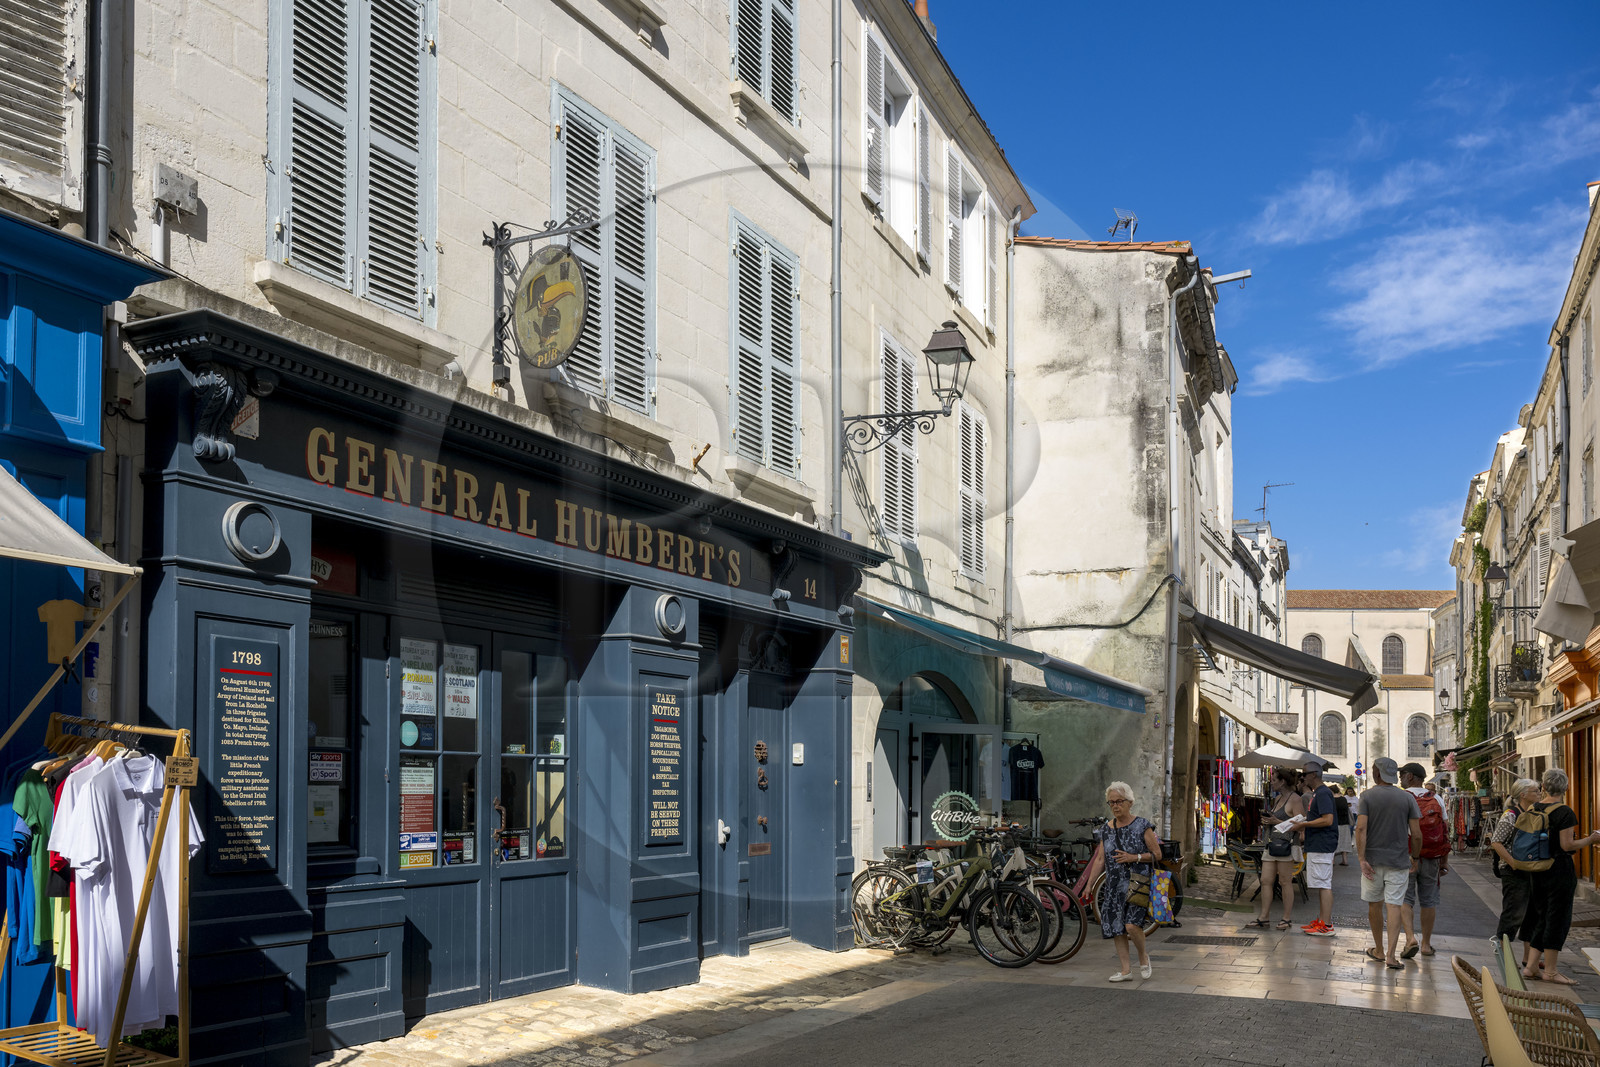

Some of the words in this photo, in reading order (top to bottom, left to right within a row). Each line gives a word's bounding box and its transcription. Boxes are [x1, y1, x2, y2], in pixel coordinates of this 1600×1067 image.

[537, 349, 557, 366] PUB
[306, 427, 537, 538] GENERAL
[555, 499, 741, 586] HUMBERT'S
[311, 559, 328, 576] HY'S
[804, 578, 816, 600] 14
[232, 651, 262, 665] 1798
[407, 660, 434, 671] IRELAND
[407, 673, 434, 684] ROMANIA
[449, 678, 475, 688] SCOTLAND
[407, 690, 433, 701] ENGLAND
[452, 695, 470, 704] WALES
[656, 693, 676, 704] TAKE
[652, 704, 680, 716] NOTICE
[931, 810, 981, 824] CitiBike
[651, 828, 680, 836] PREMISES.
[410, 855, 430, 863] SPORTS
